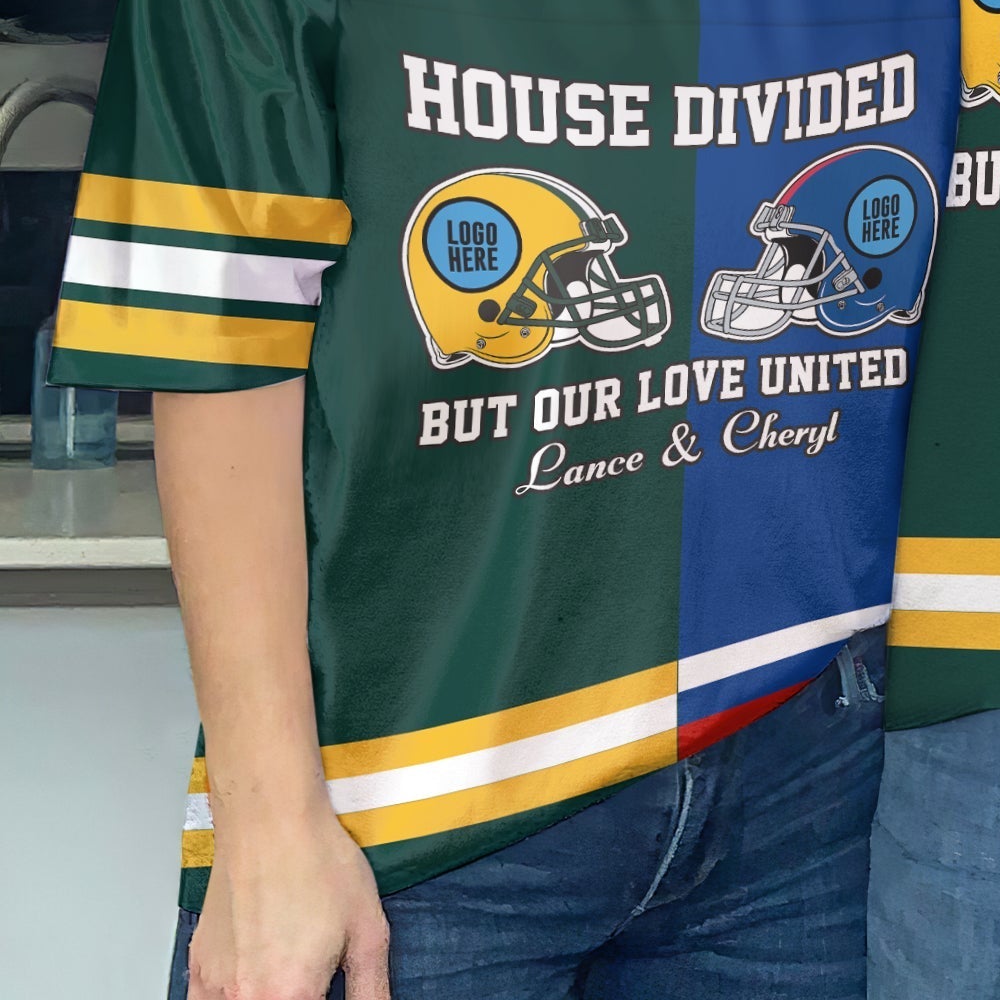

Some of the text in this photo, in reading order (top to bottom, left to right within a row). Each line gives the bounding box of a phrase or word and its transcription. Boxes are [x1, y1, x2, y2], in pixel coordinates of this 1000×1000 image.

[402, 53, 916, 147] HOUSE DIVIDED
[863, 193, 900, 219] LOGO
[447, 219, 498, 247] LOGO
[862, 217, 900, 243] HERE
[448, 246, 499, 273] HERE
[419, 348, 908, 447] BUT OUR LOVE UNITED
[515, 410, 839, 495] Lance & Cheryl
